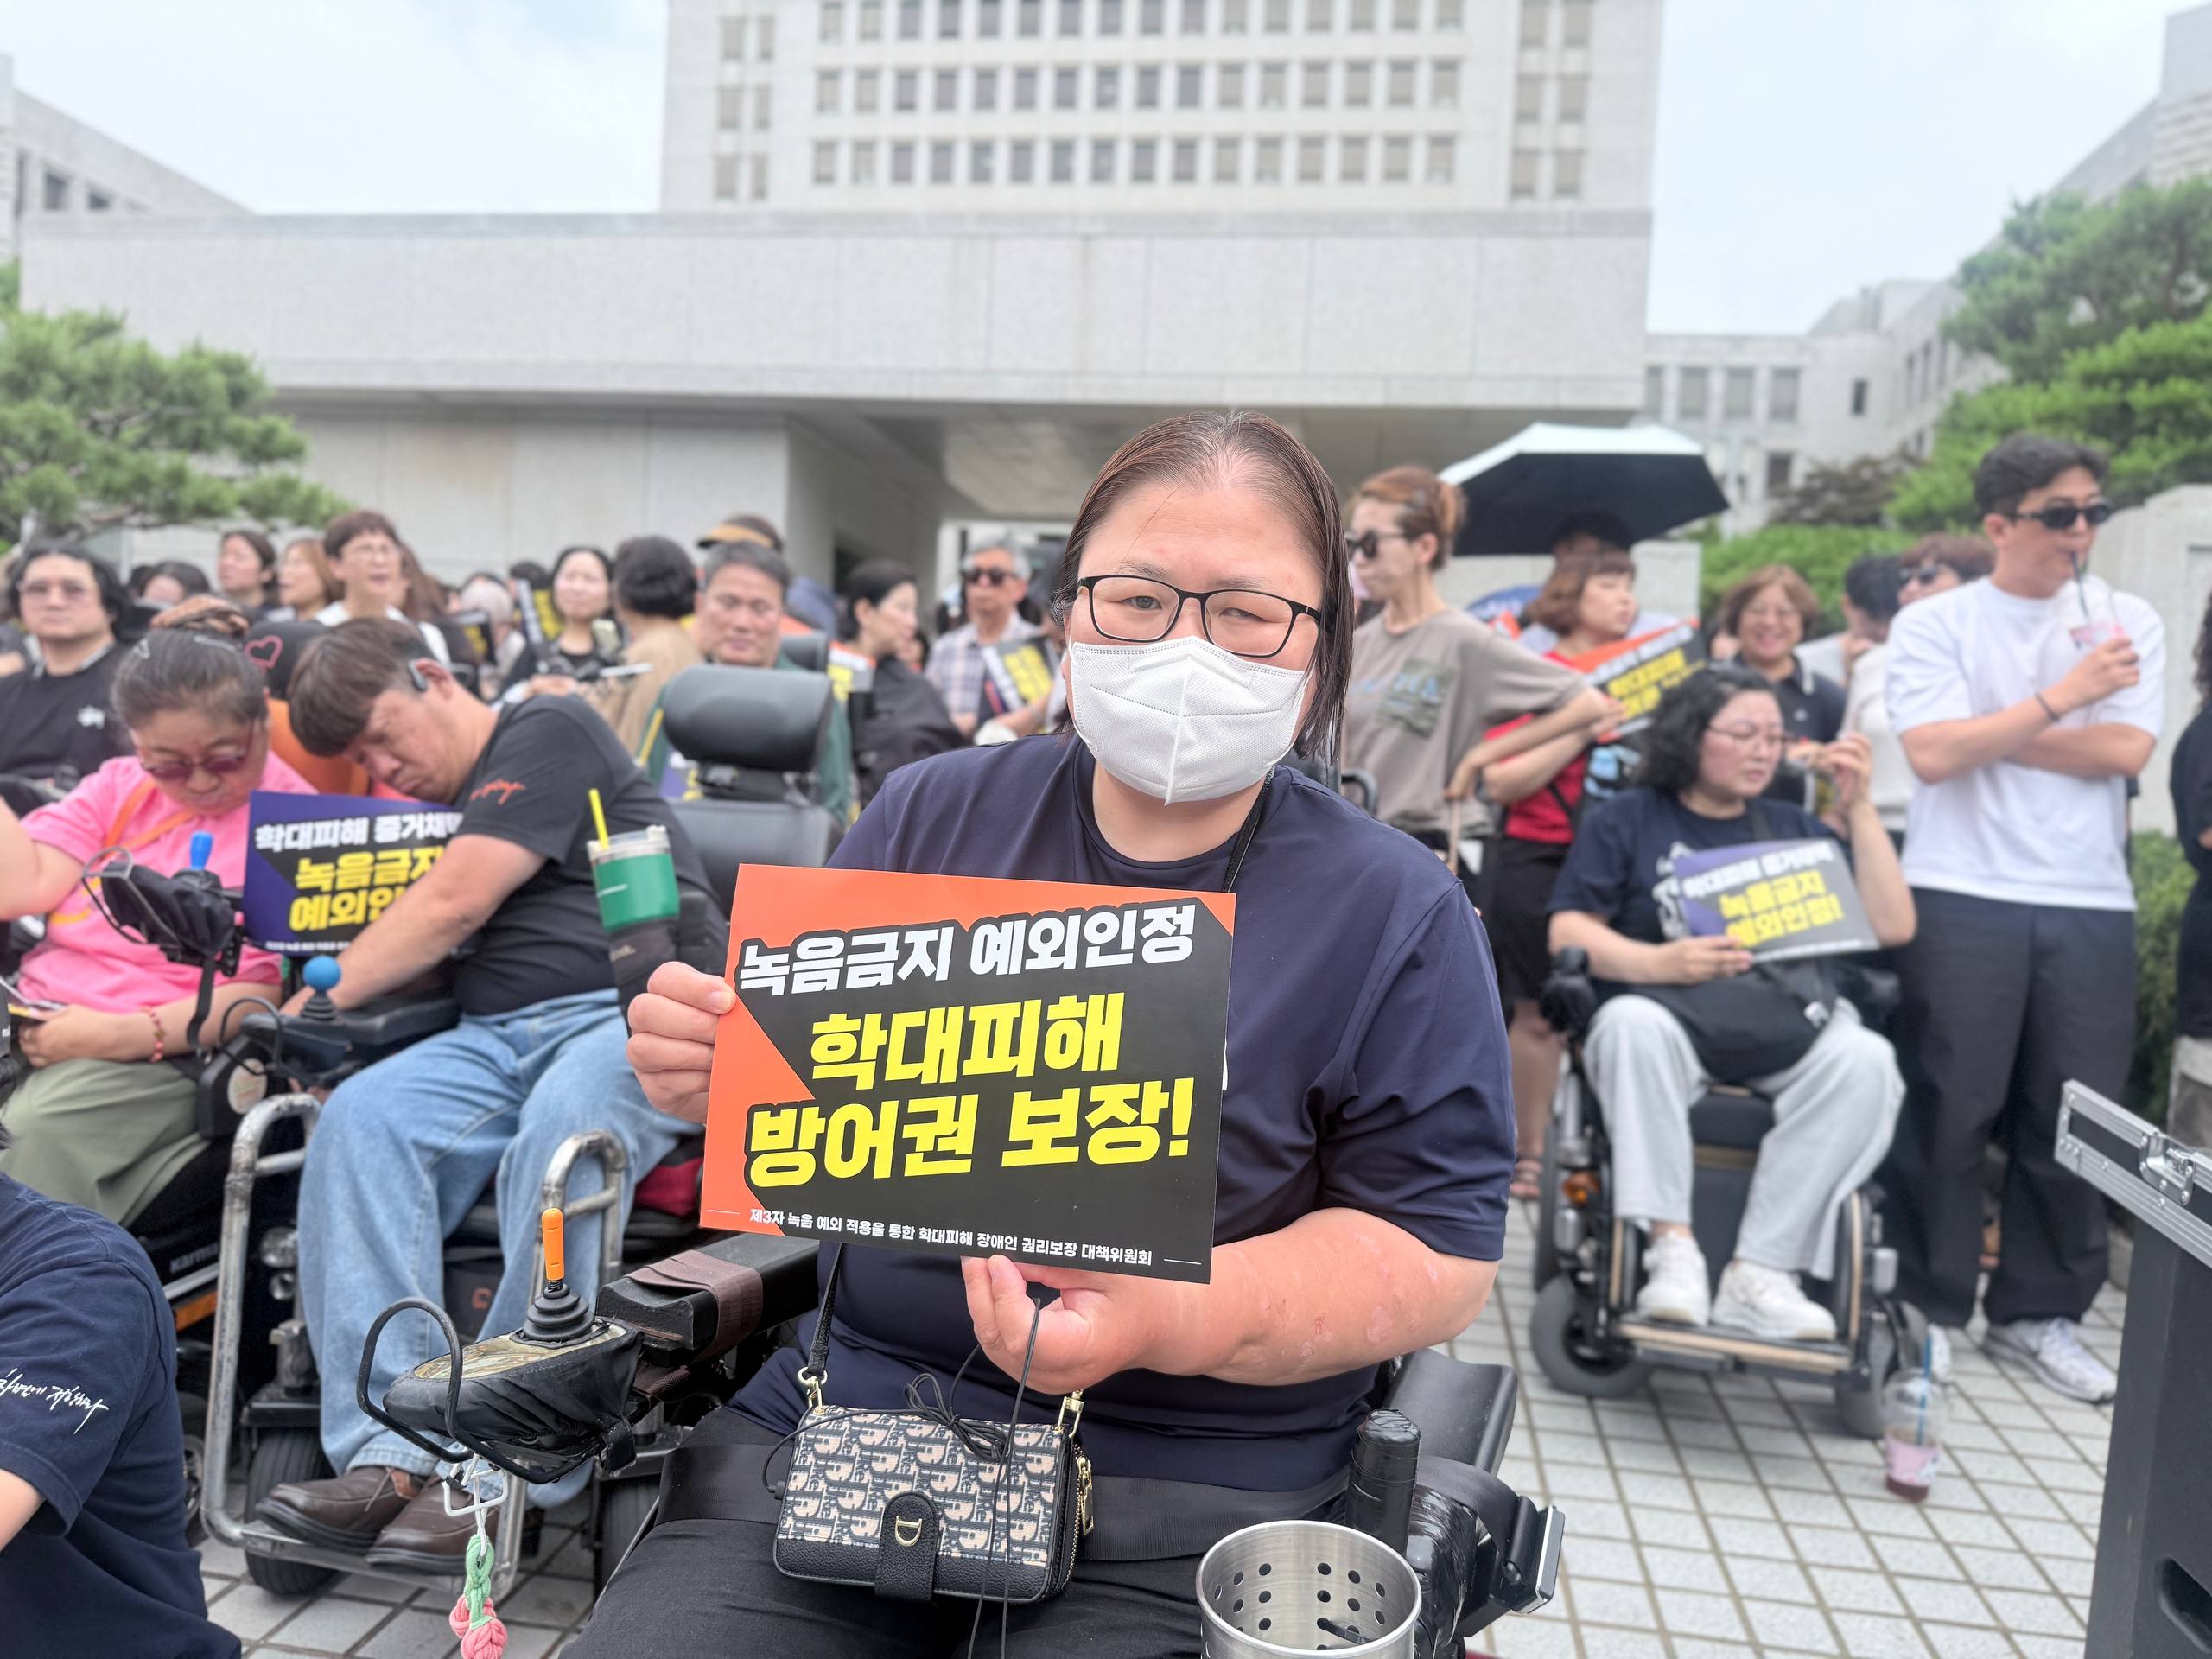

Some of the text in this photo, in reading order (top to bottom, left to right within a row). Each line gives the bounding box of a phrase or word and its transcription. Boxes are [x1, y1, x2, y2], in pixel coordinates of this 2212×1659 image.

[256, 817, 370, 853] 학대피해
[740, 903, 1197, 997] 녹음금지 예외인정
[810, 992, 1126, 1091] 학대피해
[747, 1077, 1195, 1188] 방어권 보장!
[749, 1207, 1153, 1267] 제3자 녹음 예외 적용을 통한 학대피해 장애인 권리보장 대책위원회
